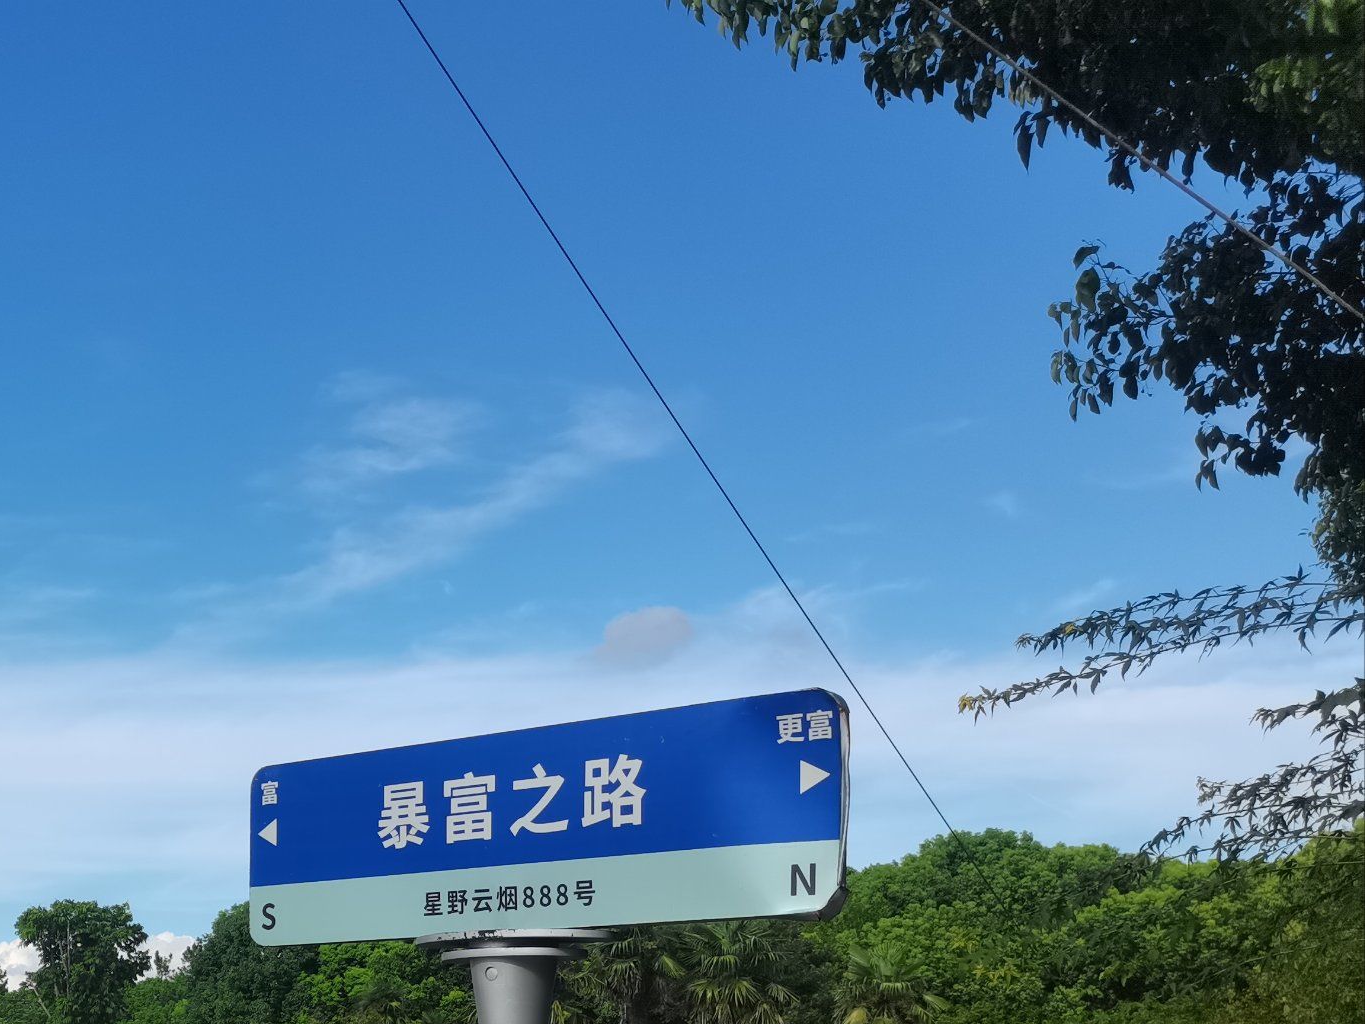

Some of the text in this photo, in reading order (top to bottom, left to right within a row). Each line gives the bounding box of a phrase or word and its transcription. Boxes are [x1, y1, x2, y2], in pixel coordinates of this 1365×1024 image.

[776, 709, 833, 745] 更富
[261, 781, 279, 806] 富
[377, 754, 647, 849] 暴富之路
[790, 863, 817, 897] N
[423, 880, 596, 917] 星野云烟888号
[261, 903, 277, 931] S
